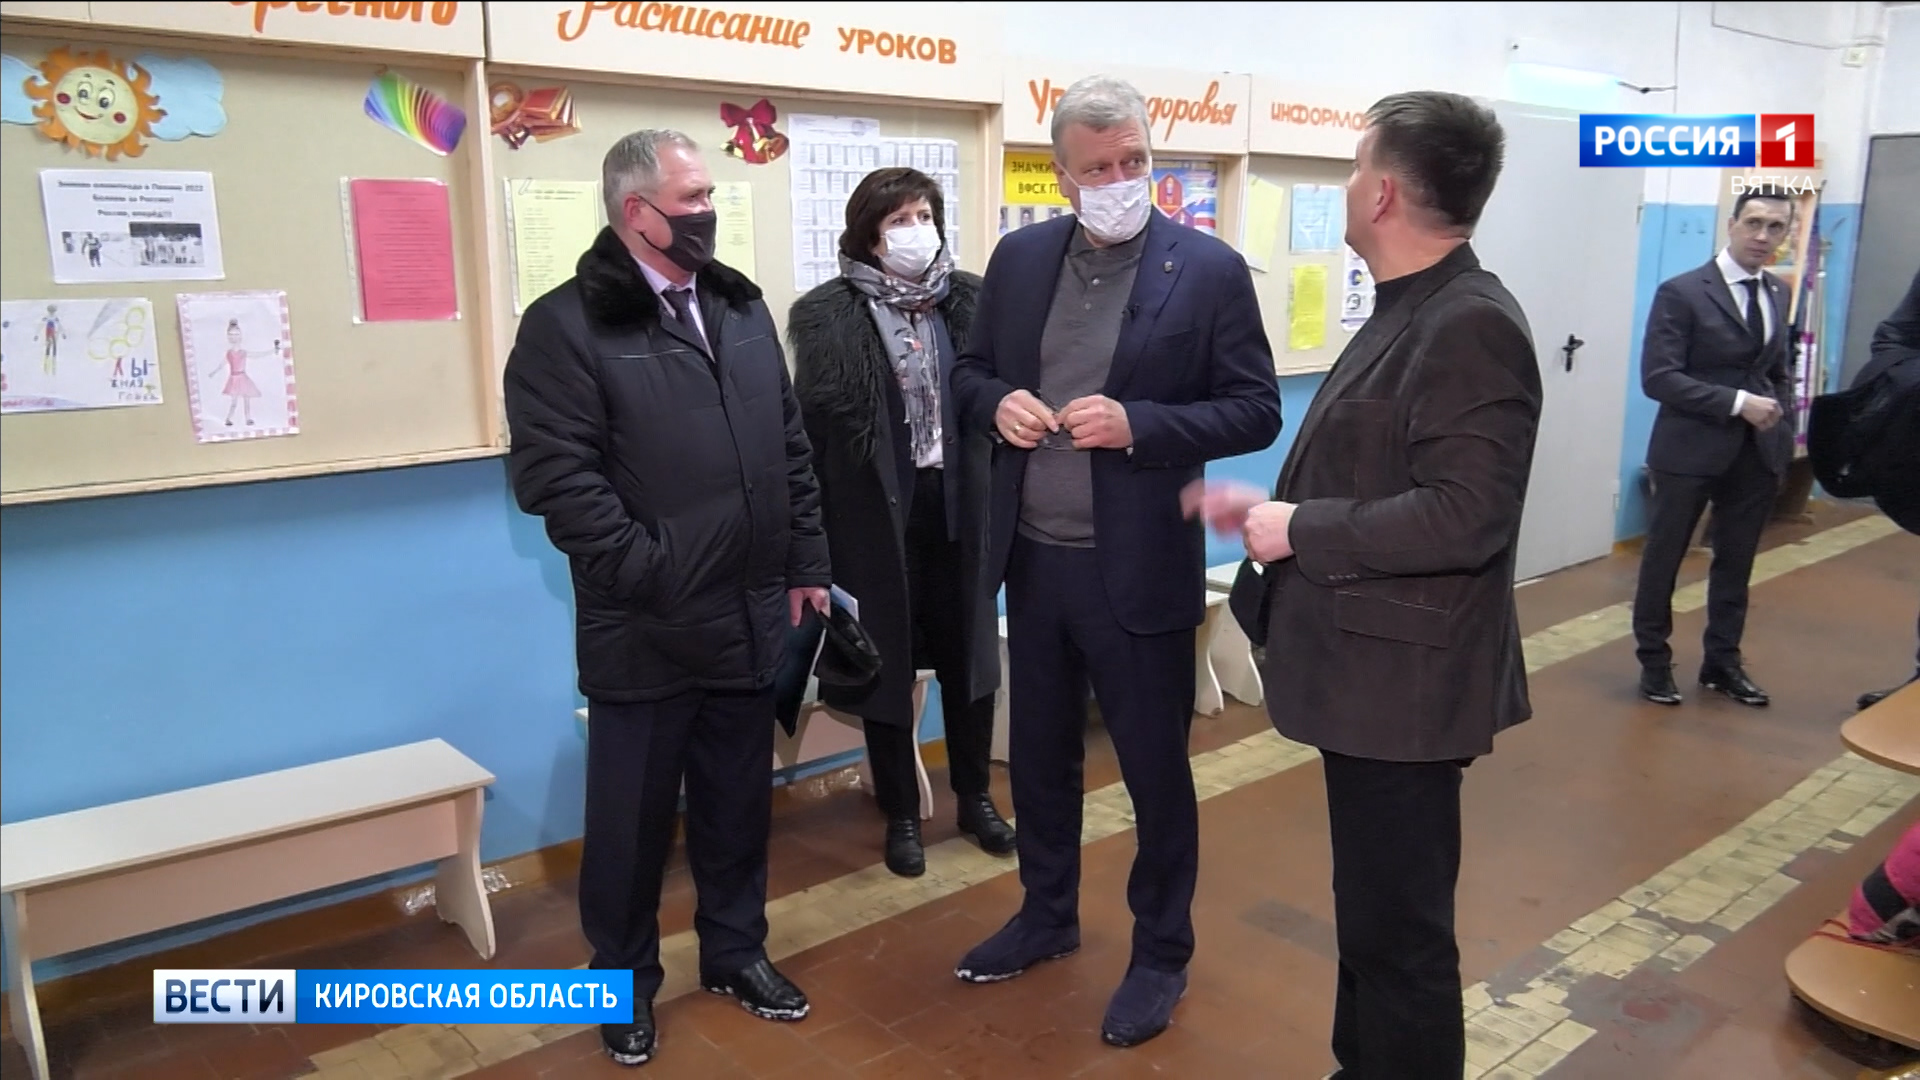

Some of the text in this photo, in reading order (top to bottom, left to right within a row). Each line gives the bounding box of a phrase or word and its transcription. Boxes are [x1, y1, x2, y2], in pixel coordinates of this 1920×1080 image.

[557, 1, 957, 65] Расписание УРОКОВ
[1145, 80, 1238, 143] доровья
